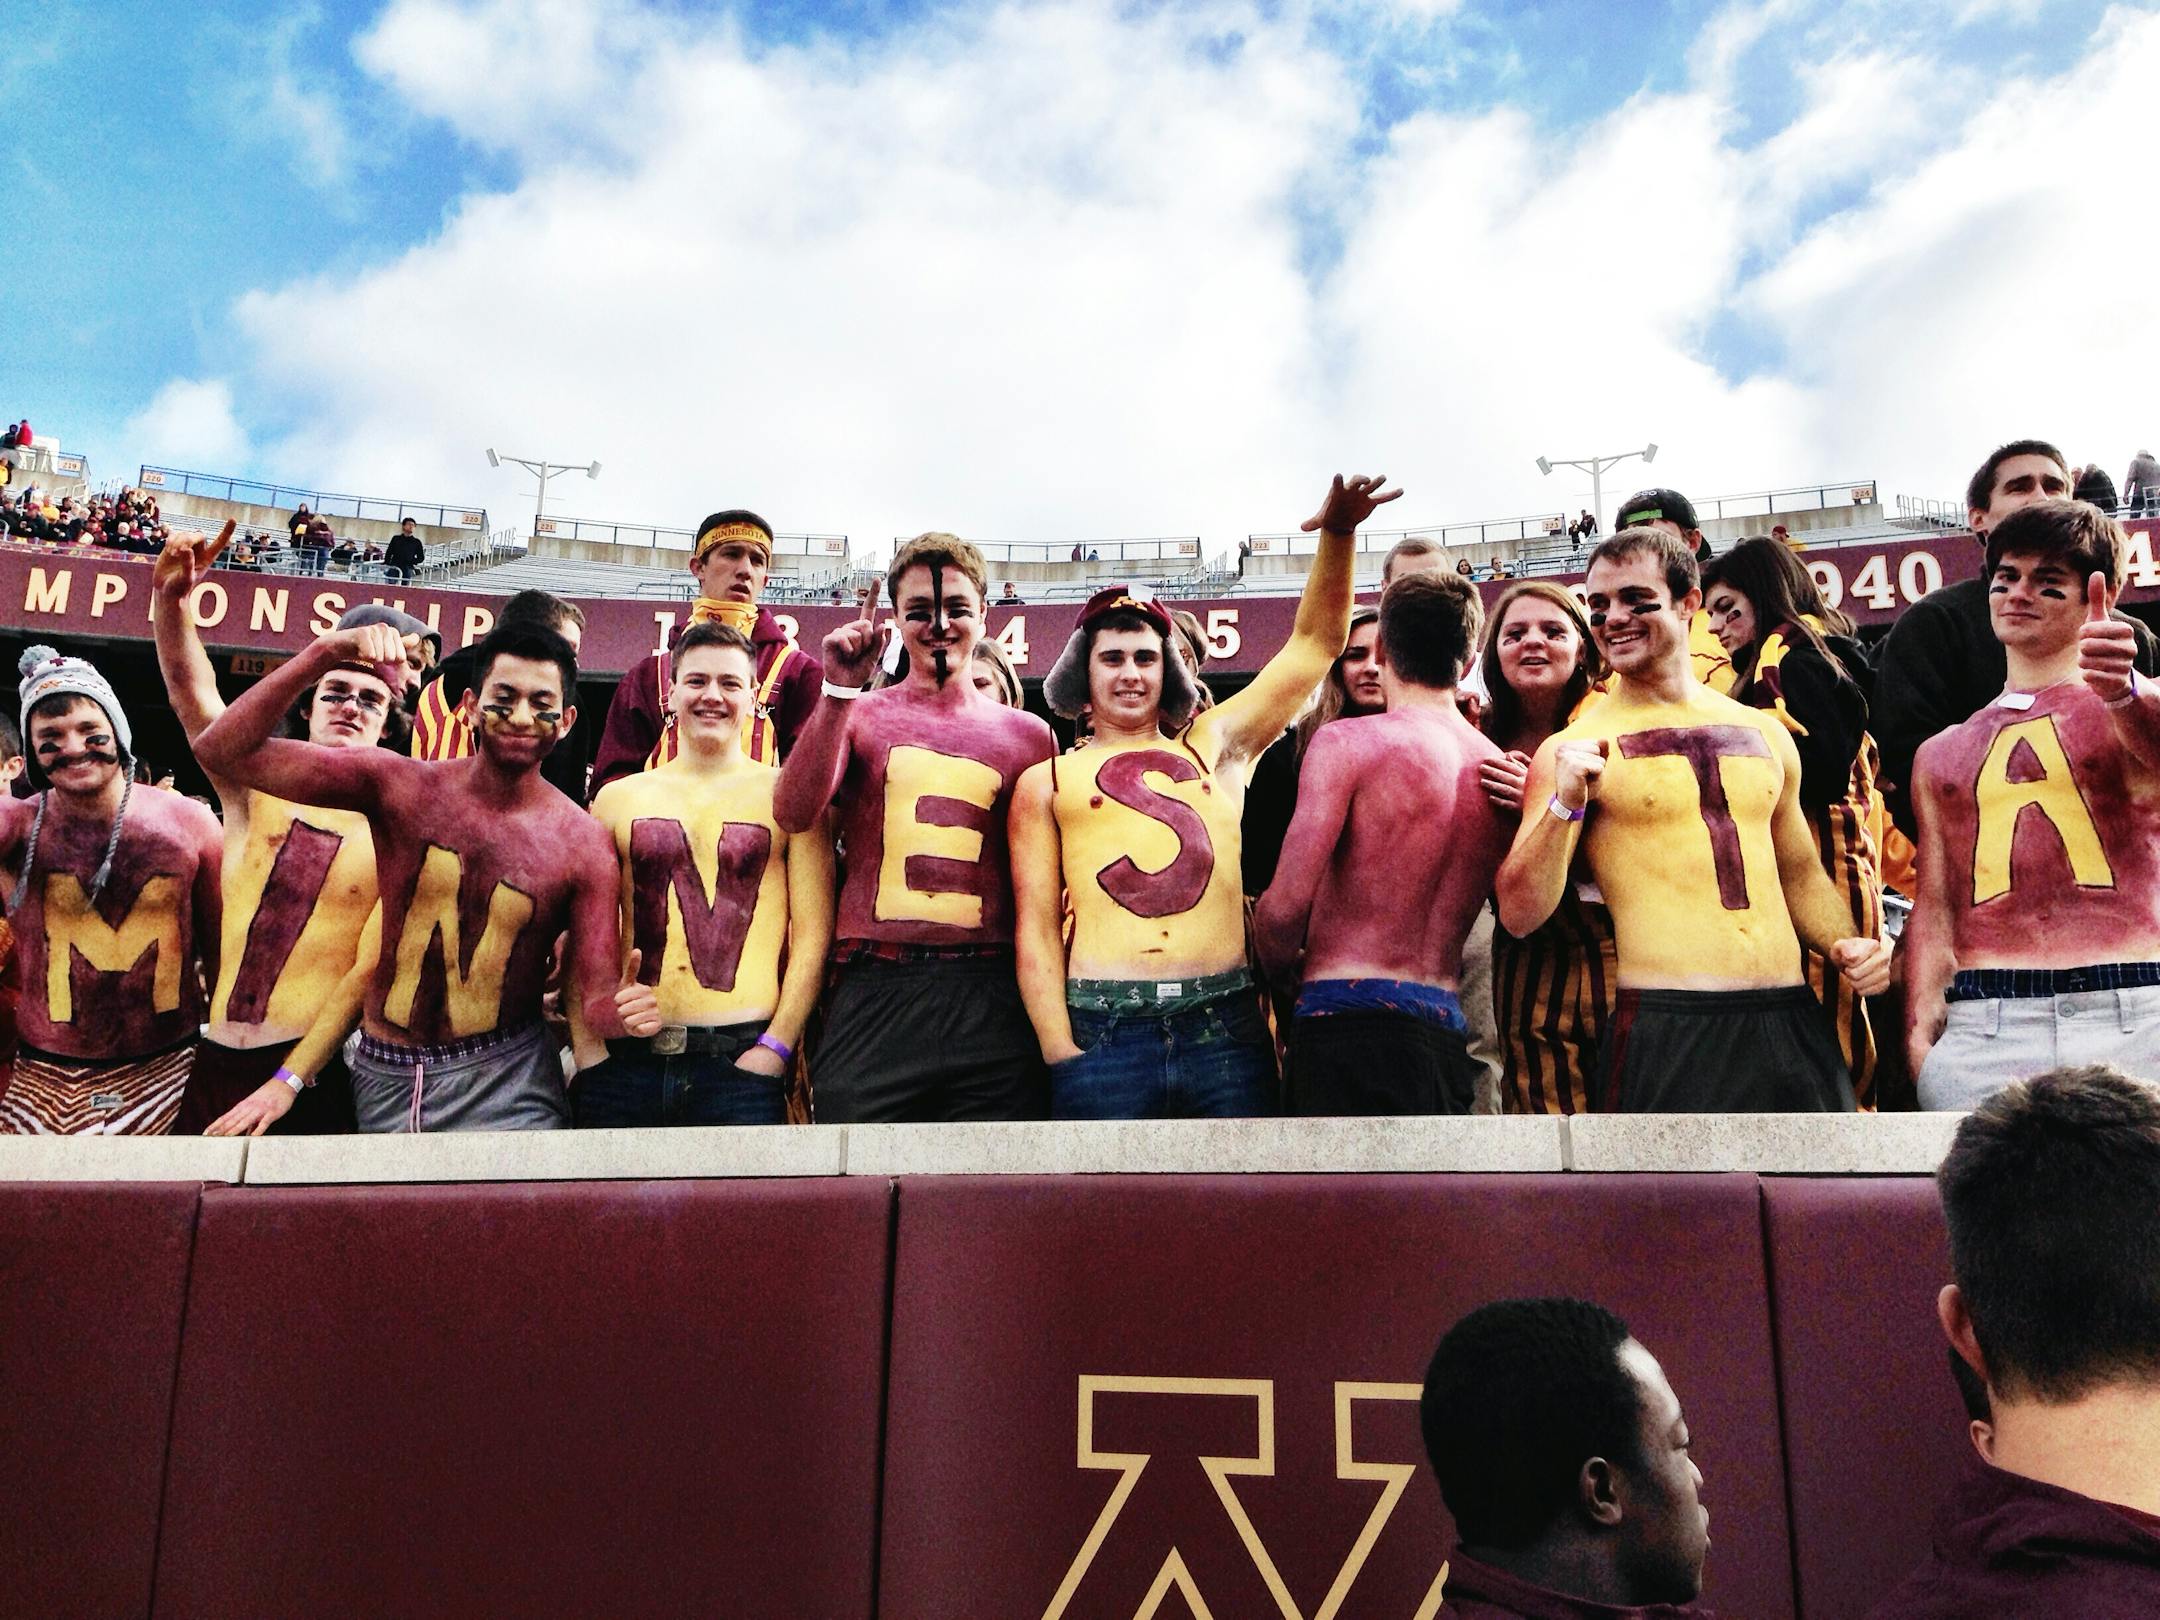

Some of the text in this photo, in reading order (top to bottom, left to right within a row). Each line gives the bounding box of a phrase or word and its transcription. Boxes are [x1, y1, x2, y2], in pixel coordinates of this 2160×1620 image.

[146, 474, 161, 483] 220
[465, 515, 479, 523] 220
[711, 527, 764, 541] MINNESOTA
[875, 745, 1004, 929] E
[1096, 748, 1214, 918] S
[1619, 727, 1771, 910] T
[1972, 714, 2118, 906] A
[44, 872, 183, 1024] M
[383, 844, 536, 1037] N
[630, 817, 771, 992] N
